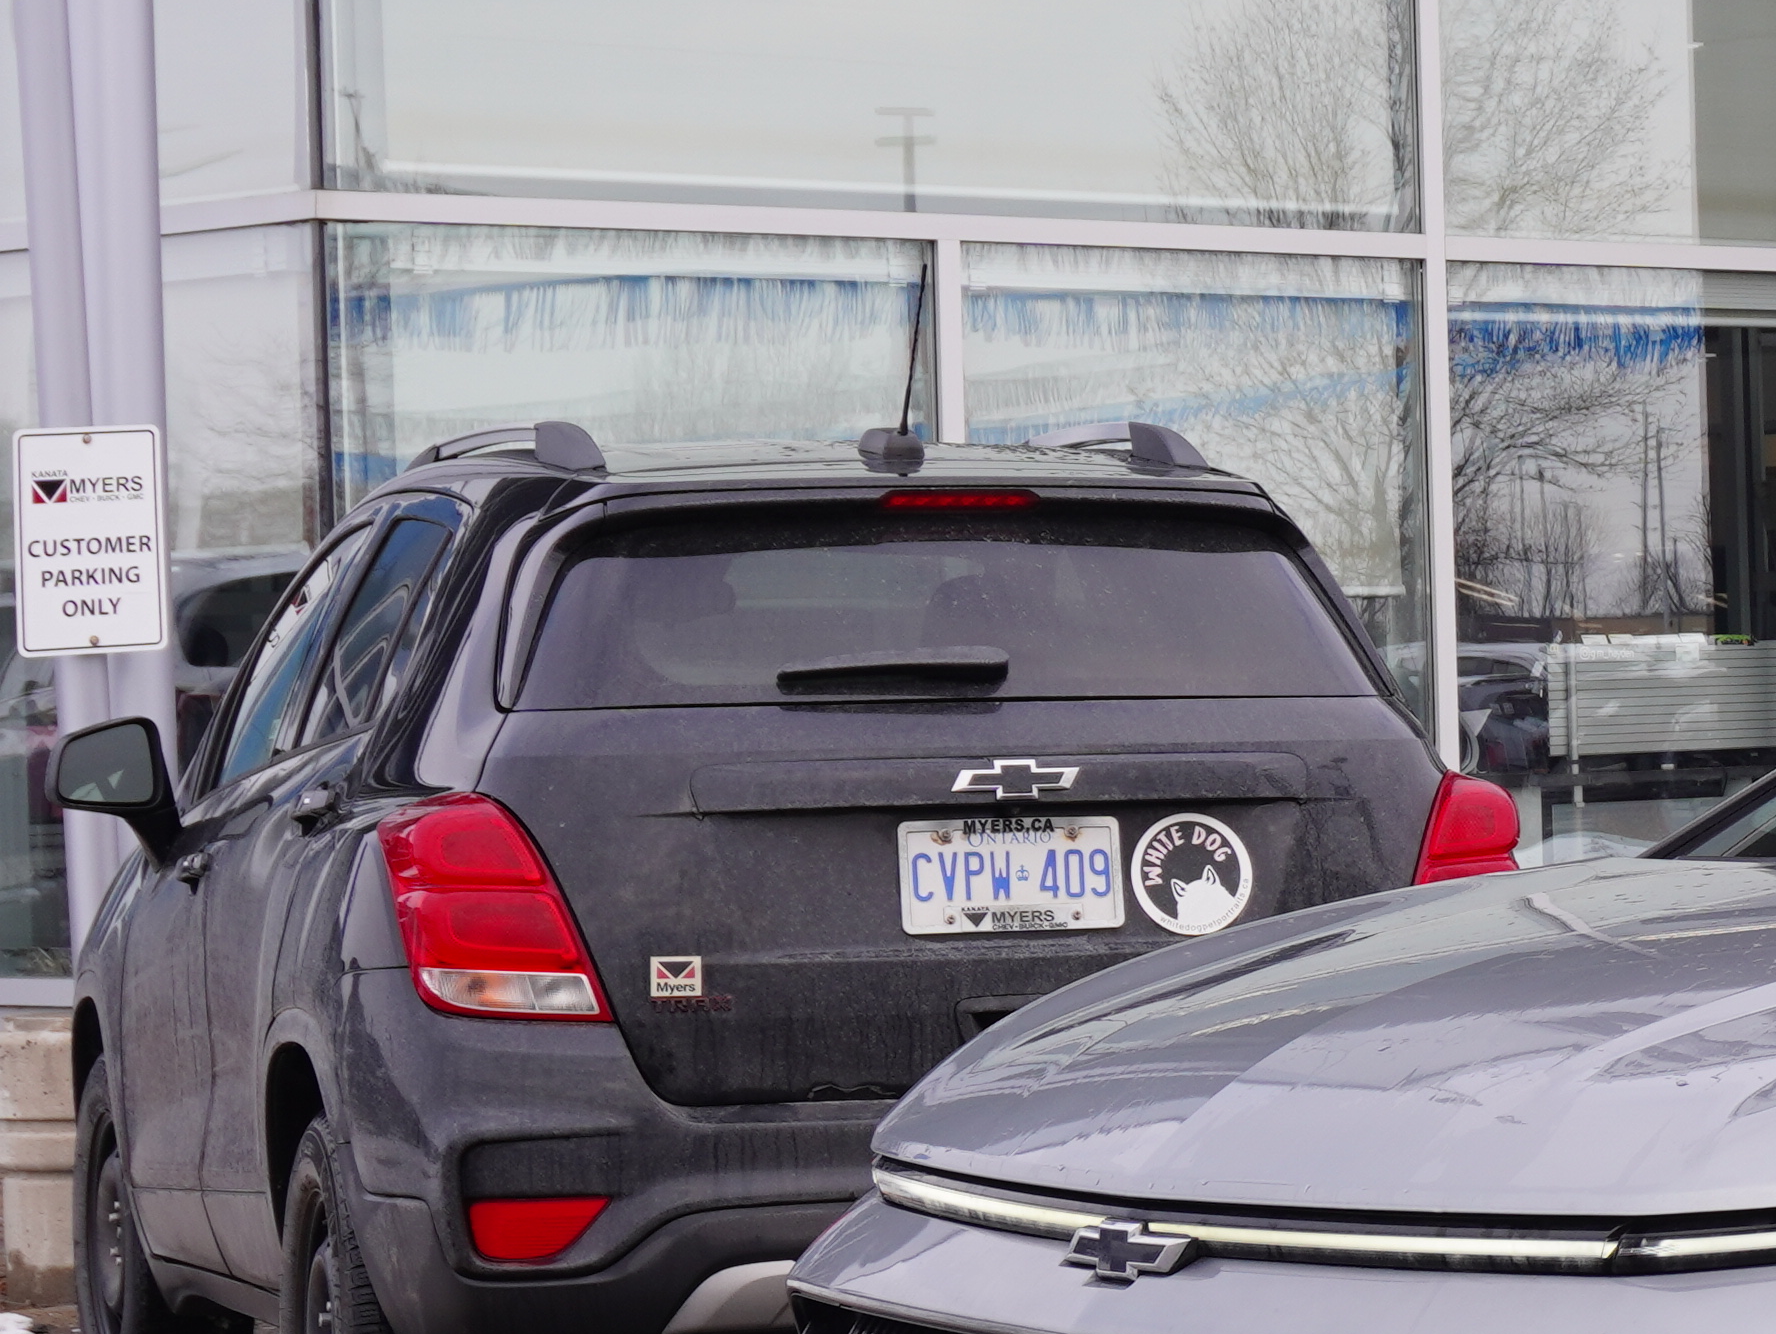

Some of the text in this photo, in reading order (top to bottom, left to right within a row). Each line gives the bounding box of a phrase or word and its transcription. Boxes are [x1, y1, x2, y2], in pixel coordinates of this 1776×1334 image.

[31, 470, 68, 479] KANATA
[69, 475, 143, 494] MYERS
[27, 535, 152, 558] CUSTOMER
[41, 566, 141, 588] PARKING
[62, 597, 122, 617] ONLY
[963, 818, 1055, 835] MYERS.CA
[967, 829, 1052, 847] ONTARIO
[1143, 825, 1231, 886] WHITE DOG
[911, 848, 1111, 902] CVPW 409
[1159, 878, 1249, 933] whitedogpetportraits.ca
[991, 910, 1055, 924] MYERS
[656, 981, 696, 995] Myers
